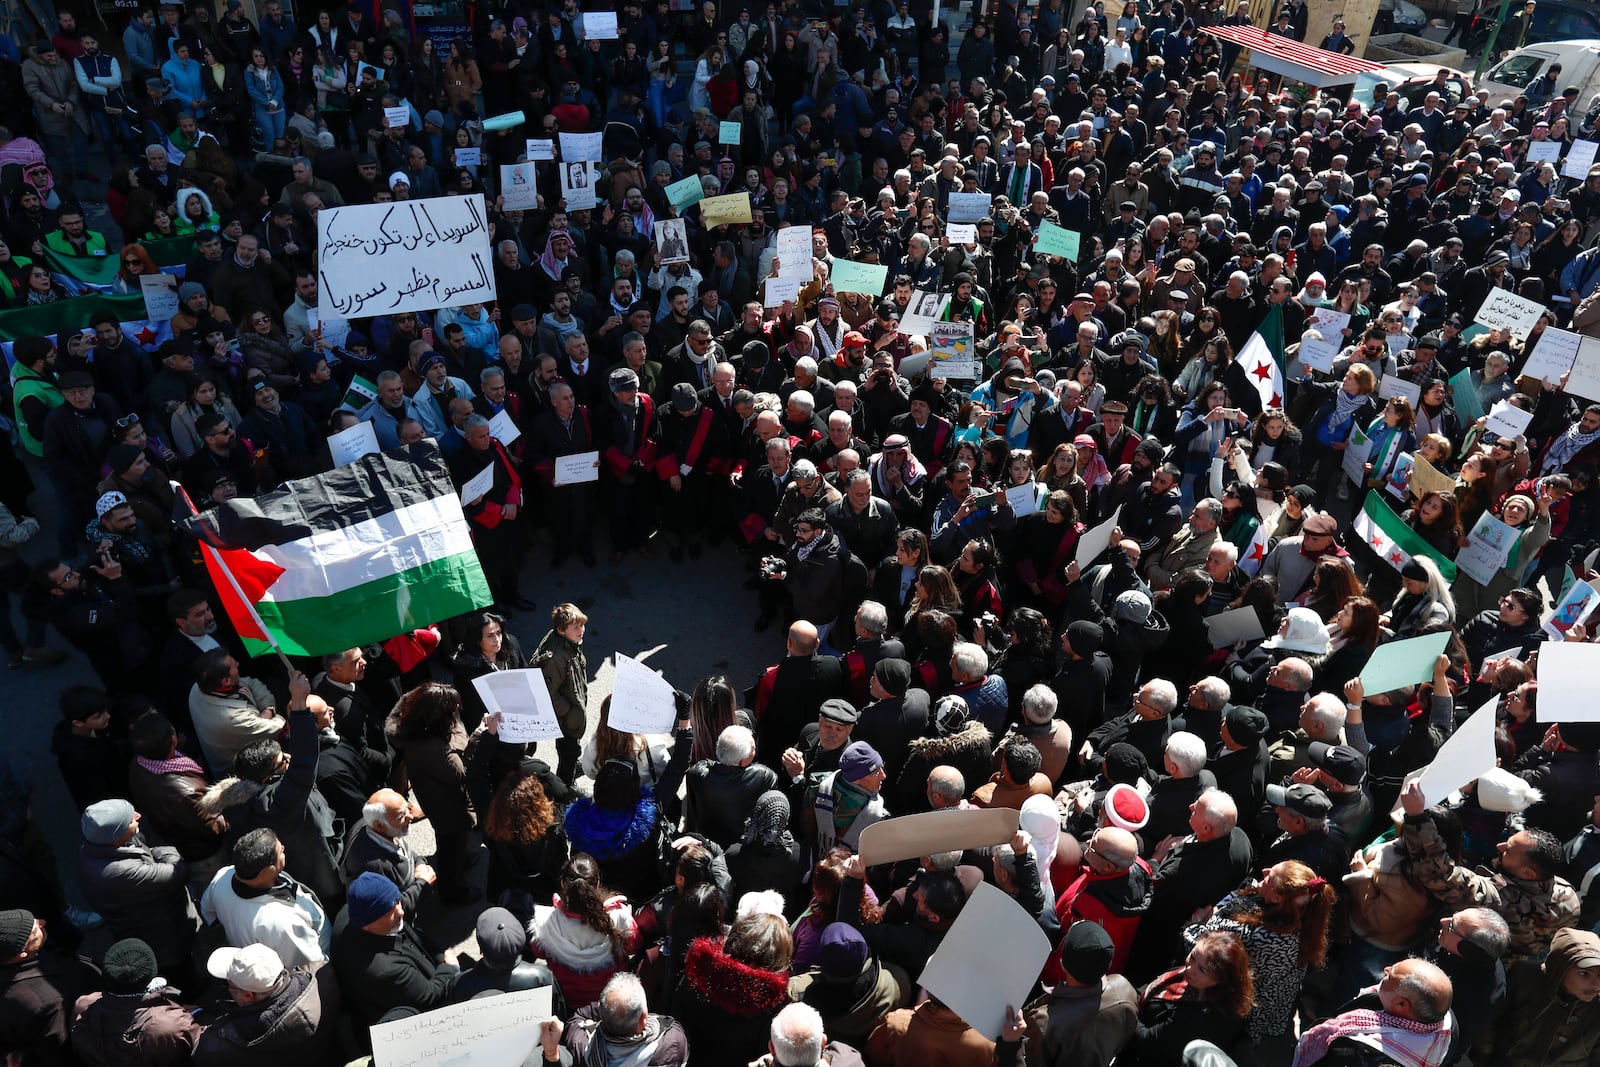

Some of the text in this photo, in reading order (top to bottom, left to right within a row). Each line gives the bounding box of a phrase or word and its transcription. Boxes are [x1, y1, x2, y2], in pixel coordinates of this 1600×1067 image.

[322, 198, 486, 264] السويداء لن تكون خنجركم
[320, 252, 491, 314] المسموم بظهر سوريا
